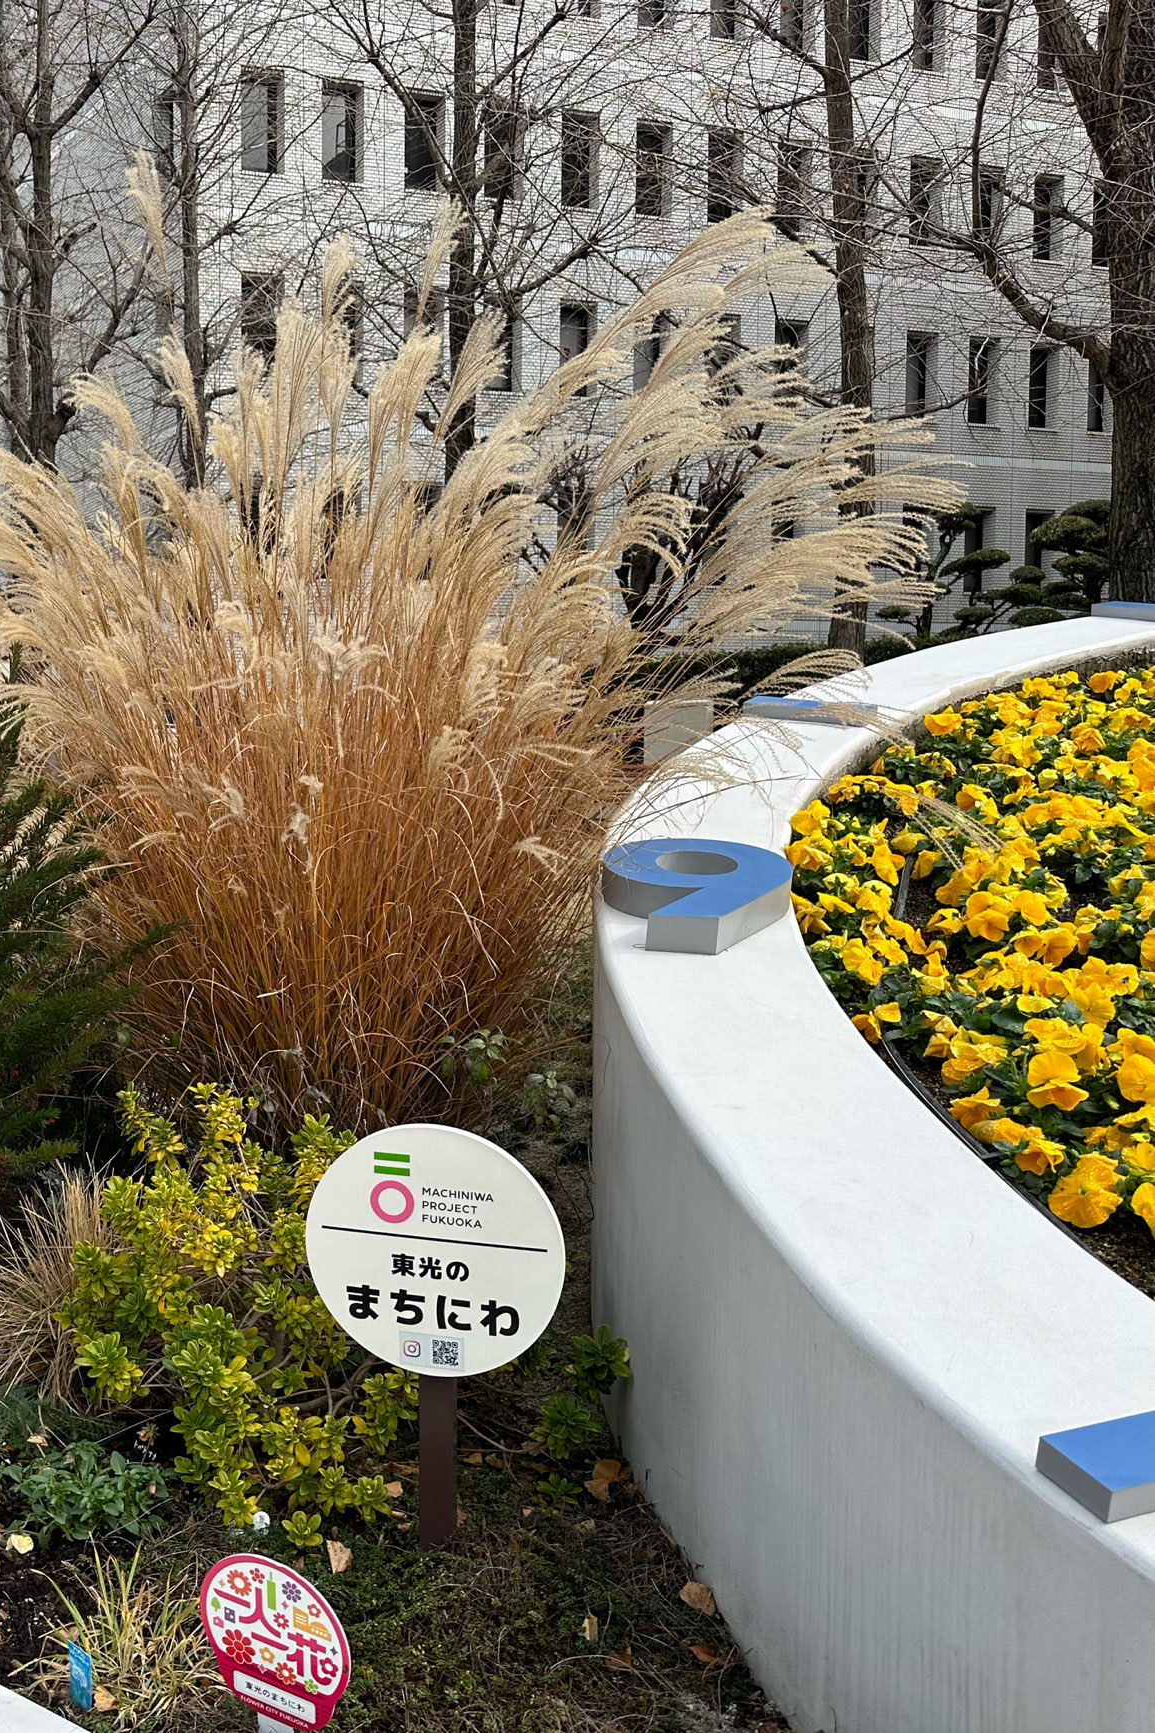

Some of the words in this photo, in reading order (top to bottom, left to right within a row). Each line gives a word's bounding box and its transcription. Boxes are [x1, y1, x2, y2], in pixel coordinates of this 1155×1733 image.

[421, 1186, 494, 1202] MACHINIWA
[421, 1200, 477, 1214] PROJECT
[421, 1214, 482, 1228] FUKUOKA
[391, 1253, 470, 1282] 東光の
[346, 1284, 520, 1336] まちにわ
[240, 1695, 264, 1710] FLOWER
[266, 1706, 279, 1715] CITY
[279, 1712, 308, 1728] FUKUOKA
[245, 1681, 305, 1713] 東光のまちにわ
